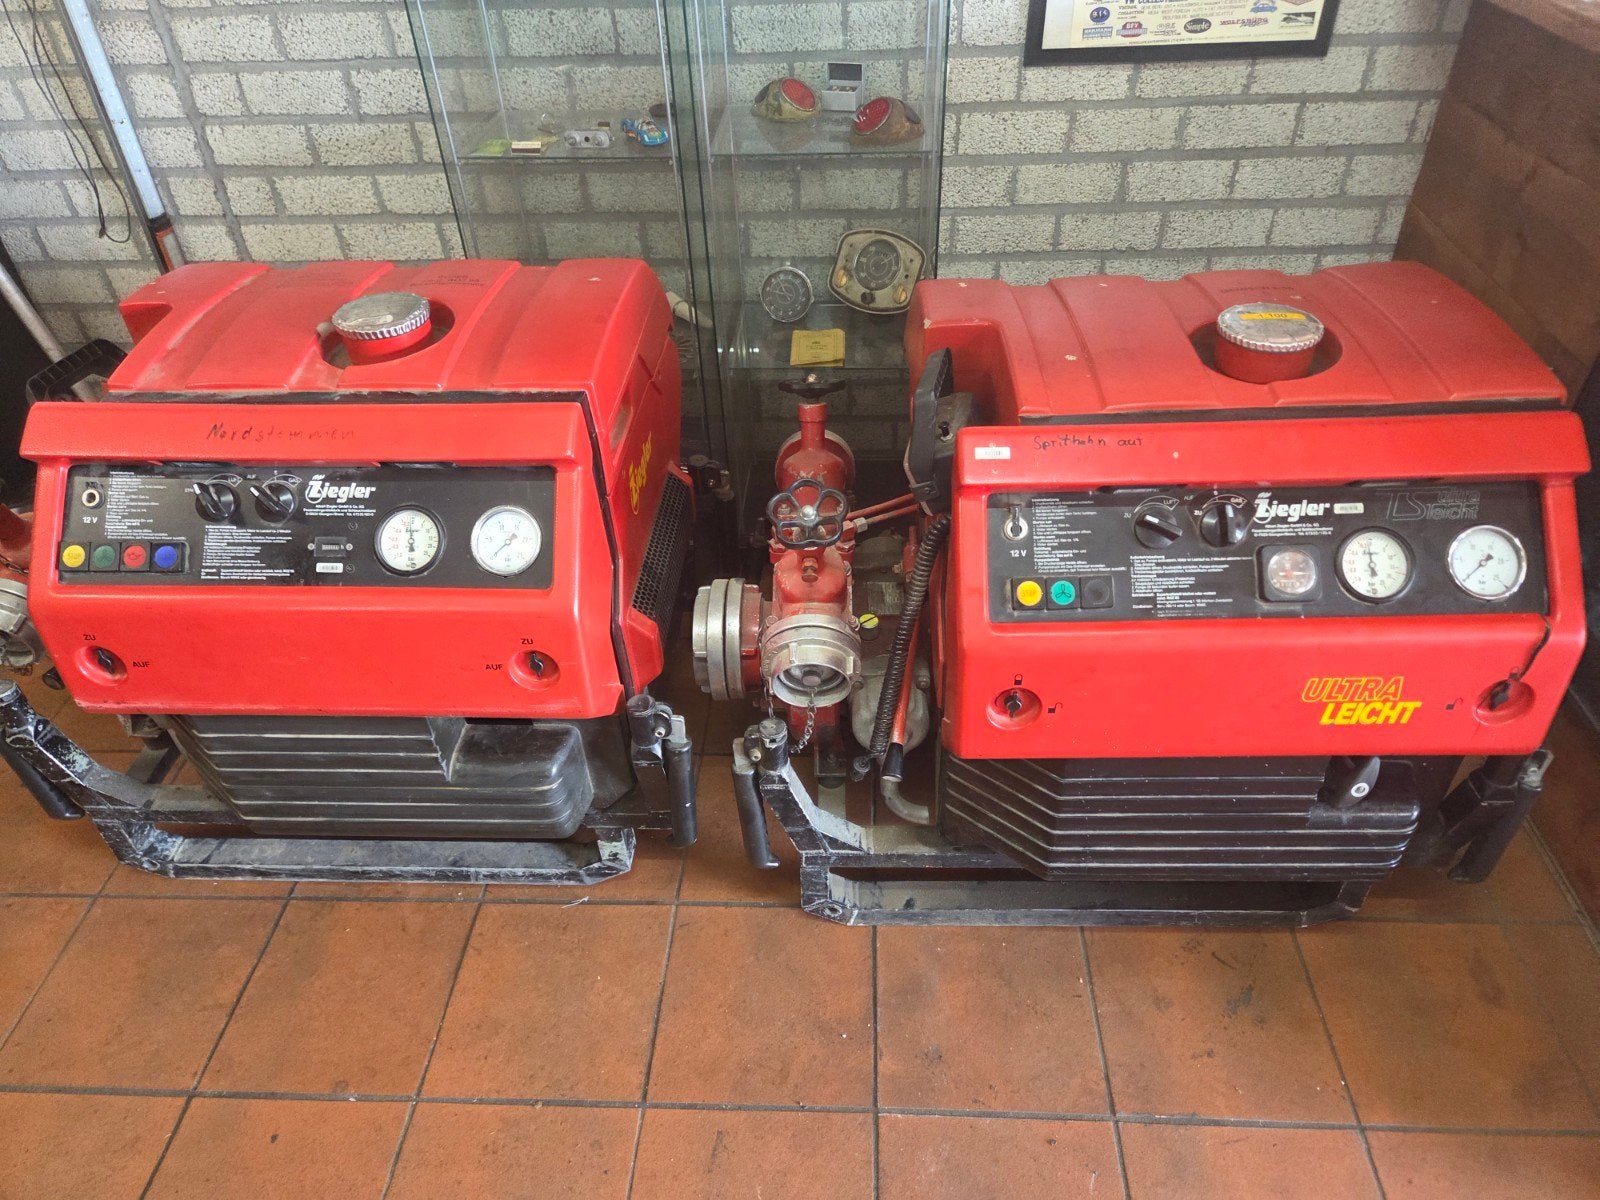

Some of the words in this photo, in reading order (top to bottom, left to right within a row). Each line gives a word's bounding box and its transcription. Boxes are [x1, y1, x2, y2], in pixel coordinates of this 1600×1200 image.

[305, 480, 376, 504] Ziegler
[1254, 498, 1330, 523] Ziegler
[1302, 676, 1404, 702] ULTRA
[1320, 702, 1422, 725] LEICHT
